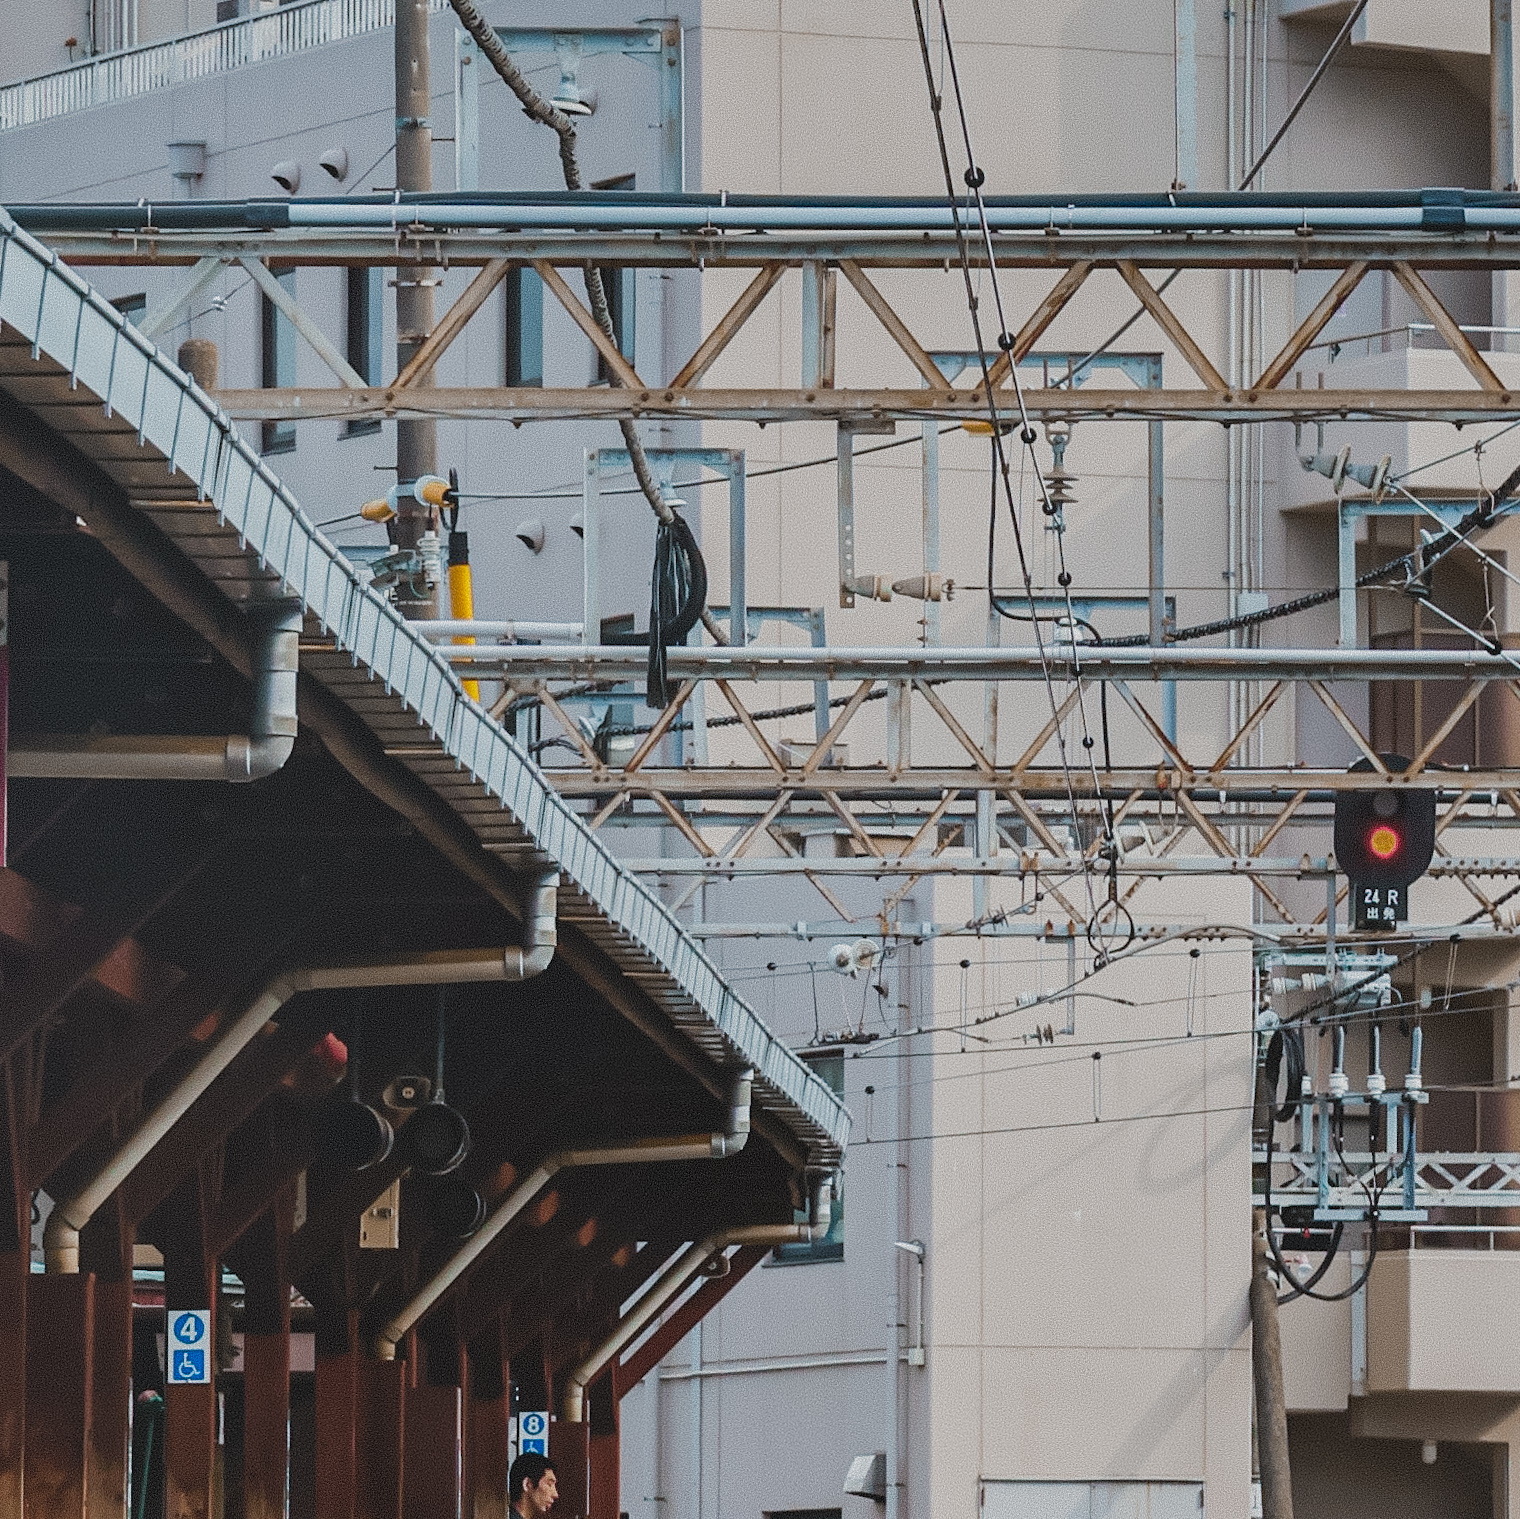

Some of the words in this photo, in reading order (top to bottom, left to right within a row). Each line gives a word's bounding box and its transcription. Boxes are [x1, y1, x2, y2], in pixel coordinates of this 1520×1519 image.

[1364, 888, 1380, 904] 24
[1387, 889, 1399, 906] R
[180, 1316, 198, 1341] 4
[527, 1416, 540, 1433] 8
